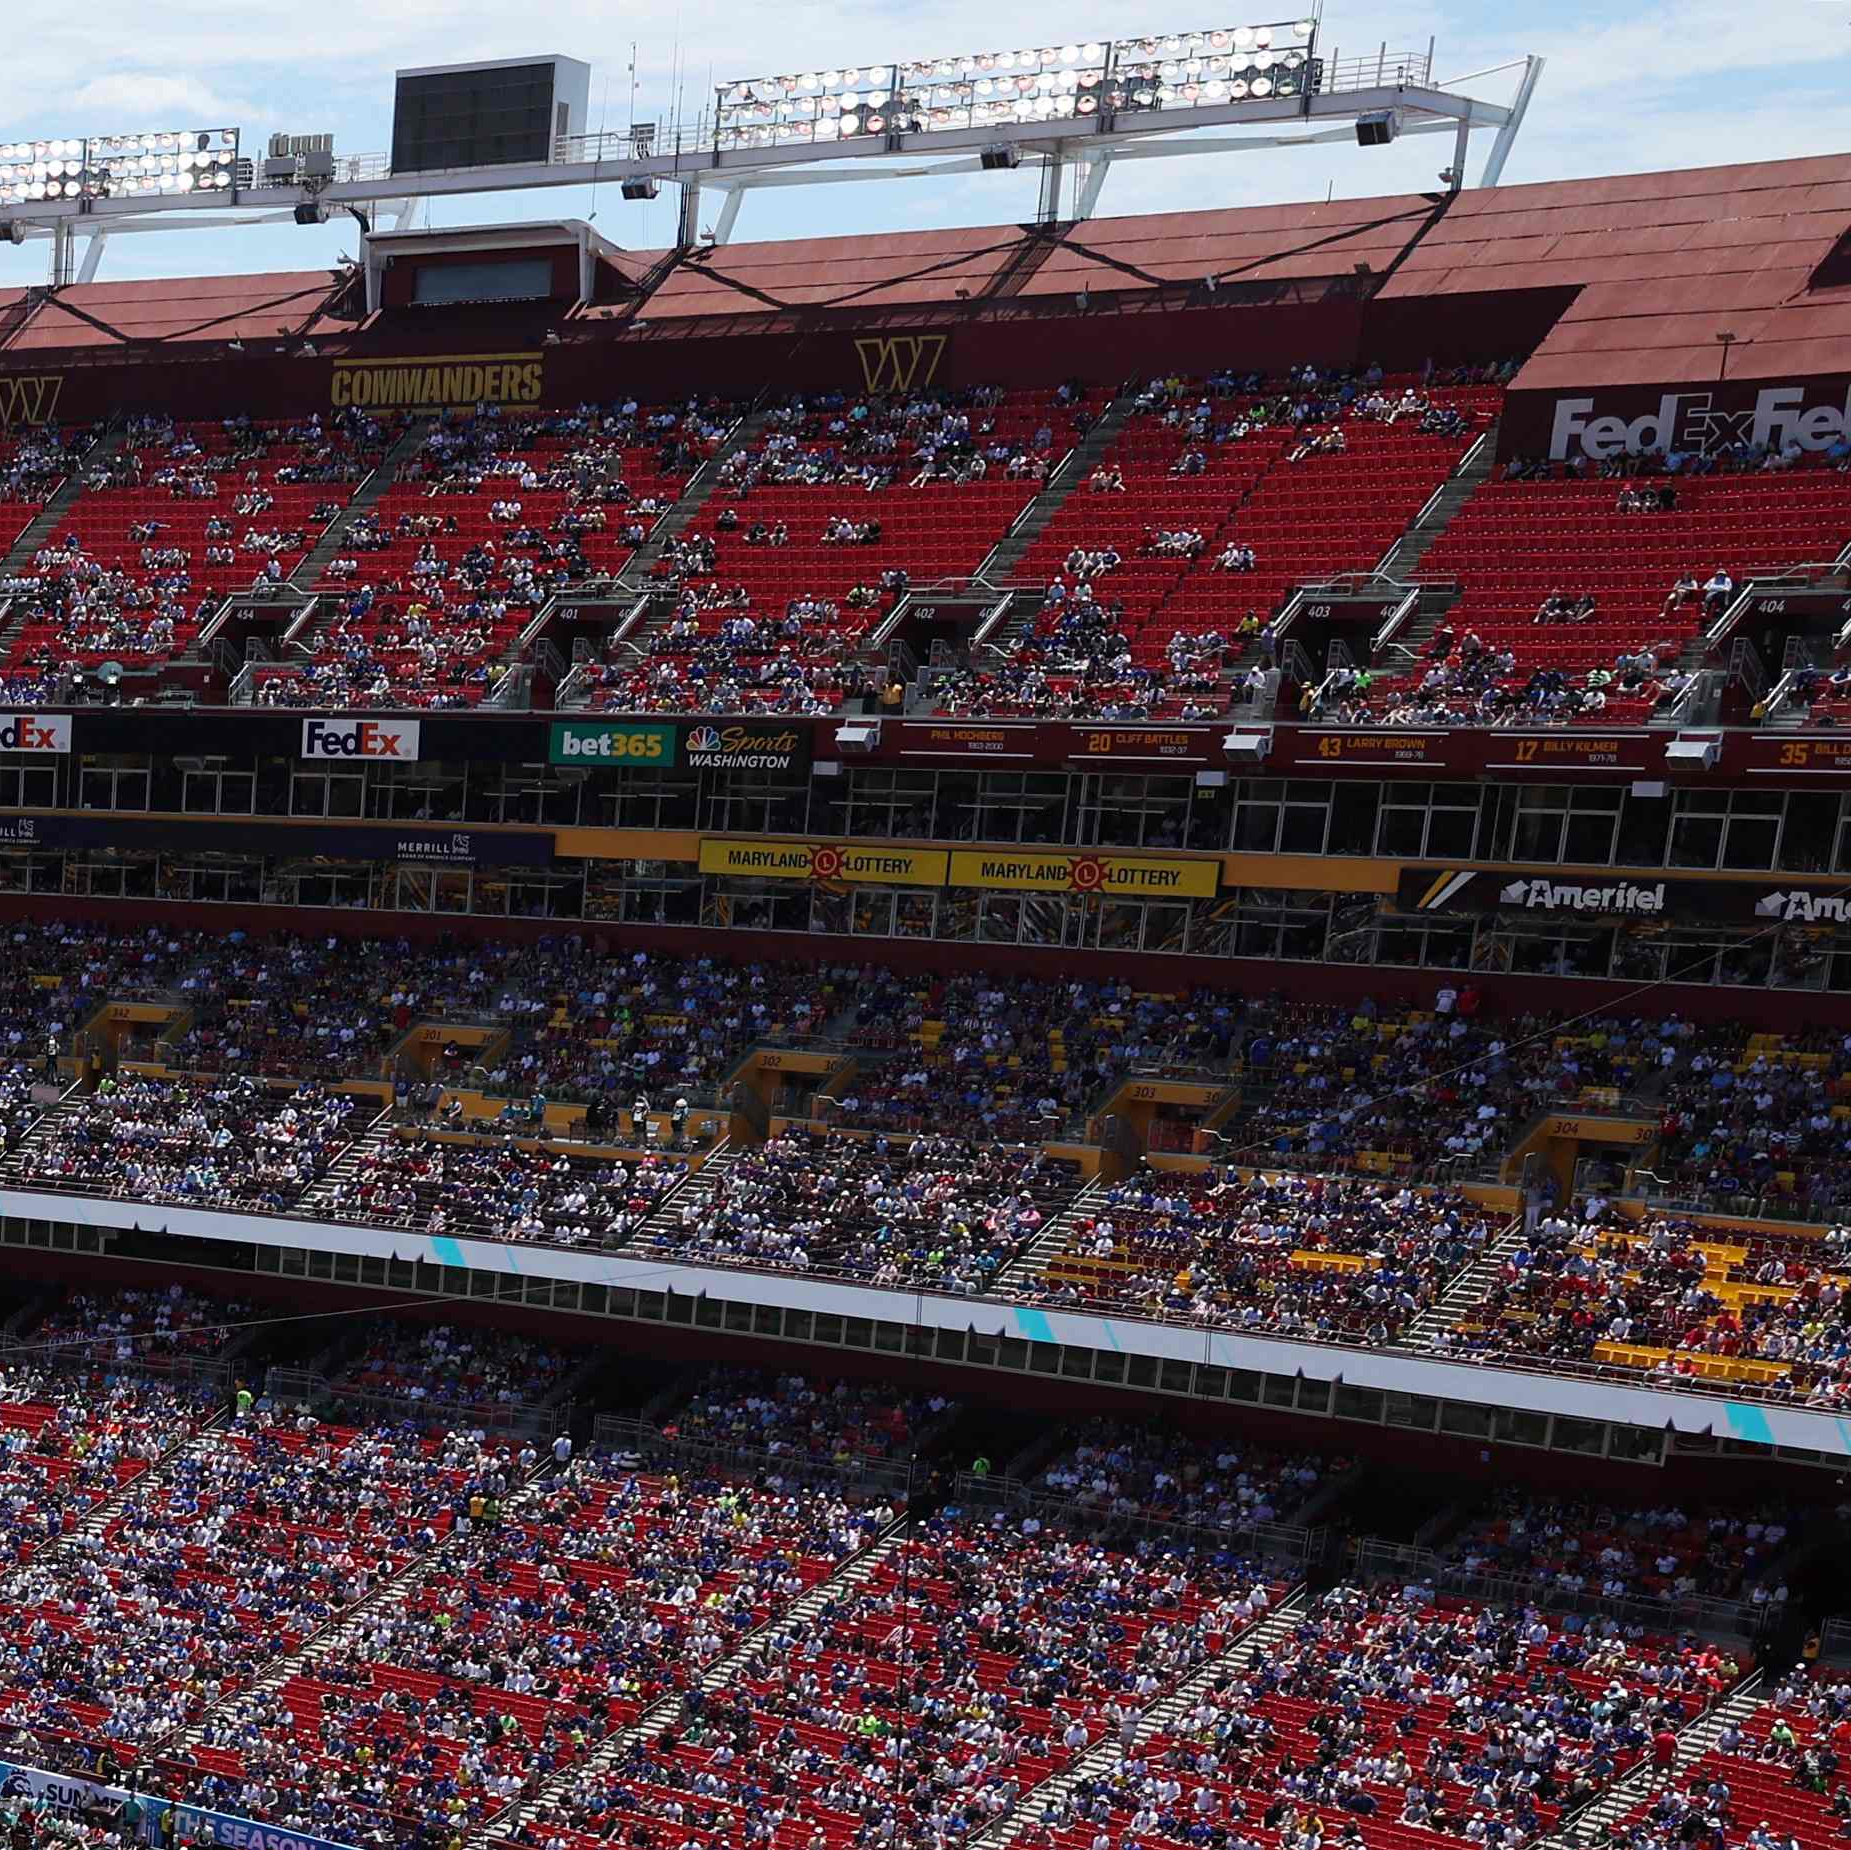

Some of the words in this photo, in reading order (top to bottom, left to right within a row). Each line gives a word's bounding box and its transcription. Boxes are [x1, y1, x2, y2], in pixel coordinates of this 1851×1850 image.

[332, 363, 544, 406] COMMANDERS
[237, 609, 255, 620] 454
[560, 608, 579, 620] 401
[914, 607, 935, 620] 402
[1308, 606, 1331, 618] 403
[1758, 600, 1786, 614] 404
[306, 721, 402, 756] FedEx
[562, 731, 664, 757] bet365
[720, 725, 798, 754] Sports
[1088, 733, 1111, 752] 20
[1115, 733, 1144, 744] CLIFF
[1144, 733, 1189, 745] BATTLES
[1317, 737, 1343, 758] 43
[1346, 737, 1384, 750] LARRY
[1385, 738, 1428, 751] BROWN
[687, 752, 791, 769] WASHINGTON
[1515, 741, 1538, 762] 17
[1542, 740, 1575, 753] BILLY
[1575, 741, 1619, 754] KILMER
[1780, 743, 1809, 766] 35
[1814, 743, 1839, 755] BILL
[397, 841, 450, 854] MERRILL
[727, 850, 807, 869] MARYLAND
[845, 857, 913, 875] LOTTERY
[981, 862, 1067, 881] MARYLAND
[1107, 868, 1182, 887] LOTTERY
[1525, 878, 1667, 911] Ameritel
[1783, 889, 1851, 924] Am
[423, 1029, 442, 1042] 301
[761, 1054, 782, 1067] 302
[1133, 1086, 1156, 1100] 303
[1554, 1121, 1580, 1136] 304
